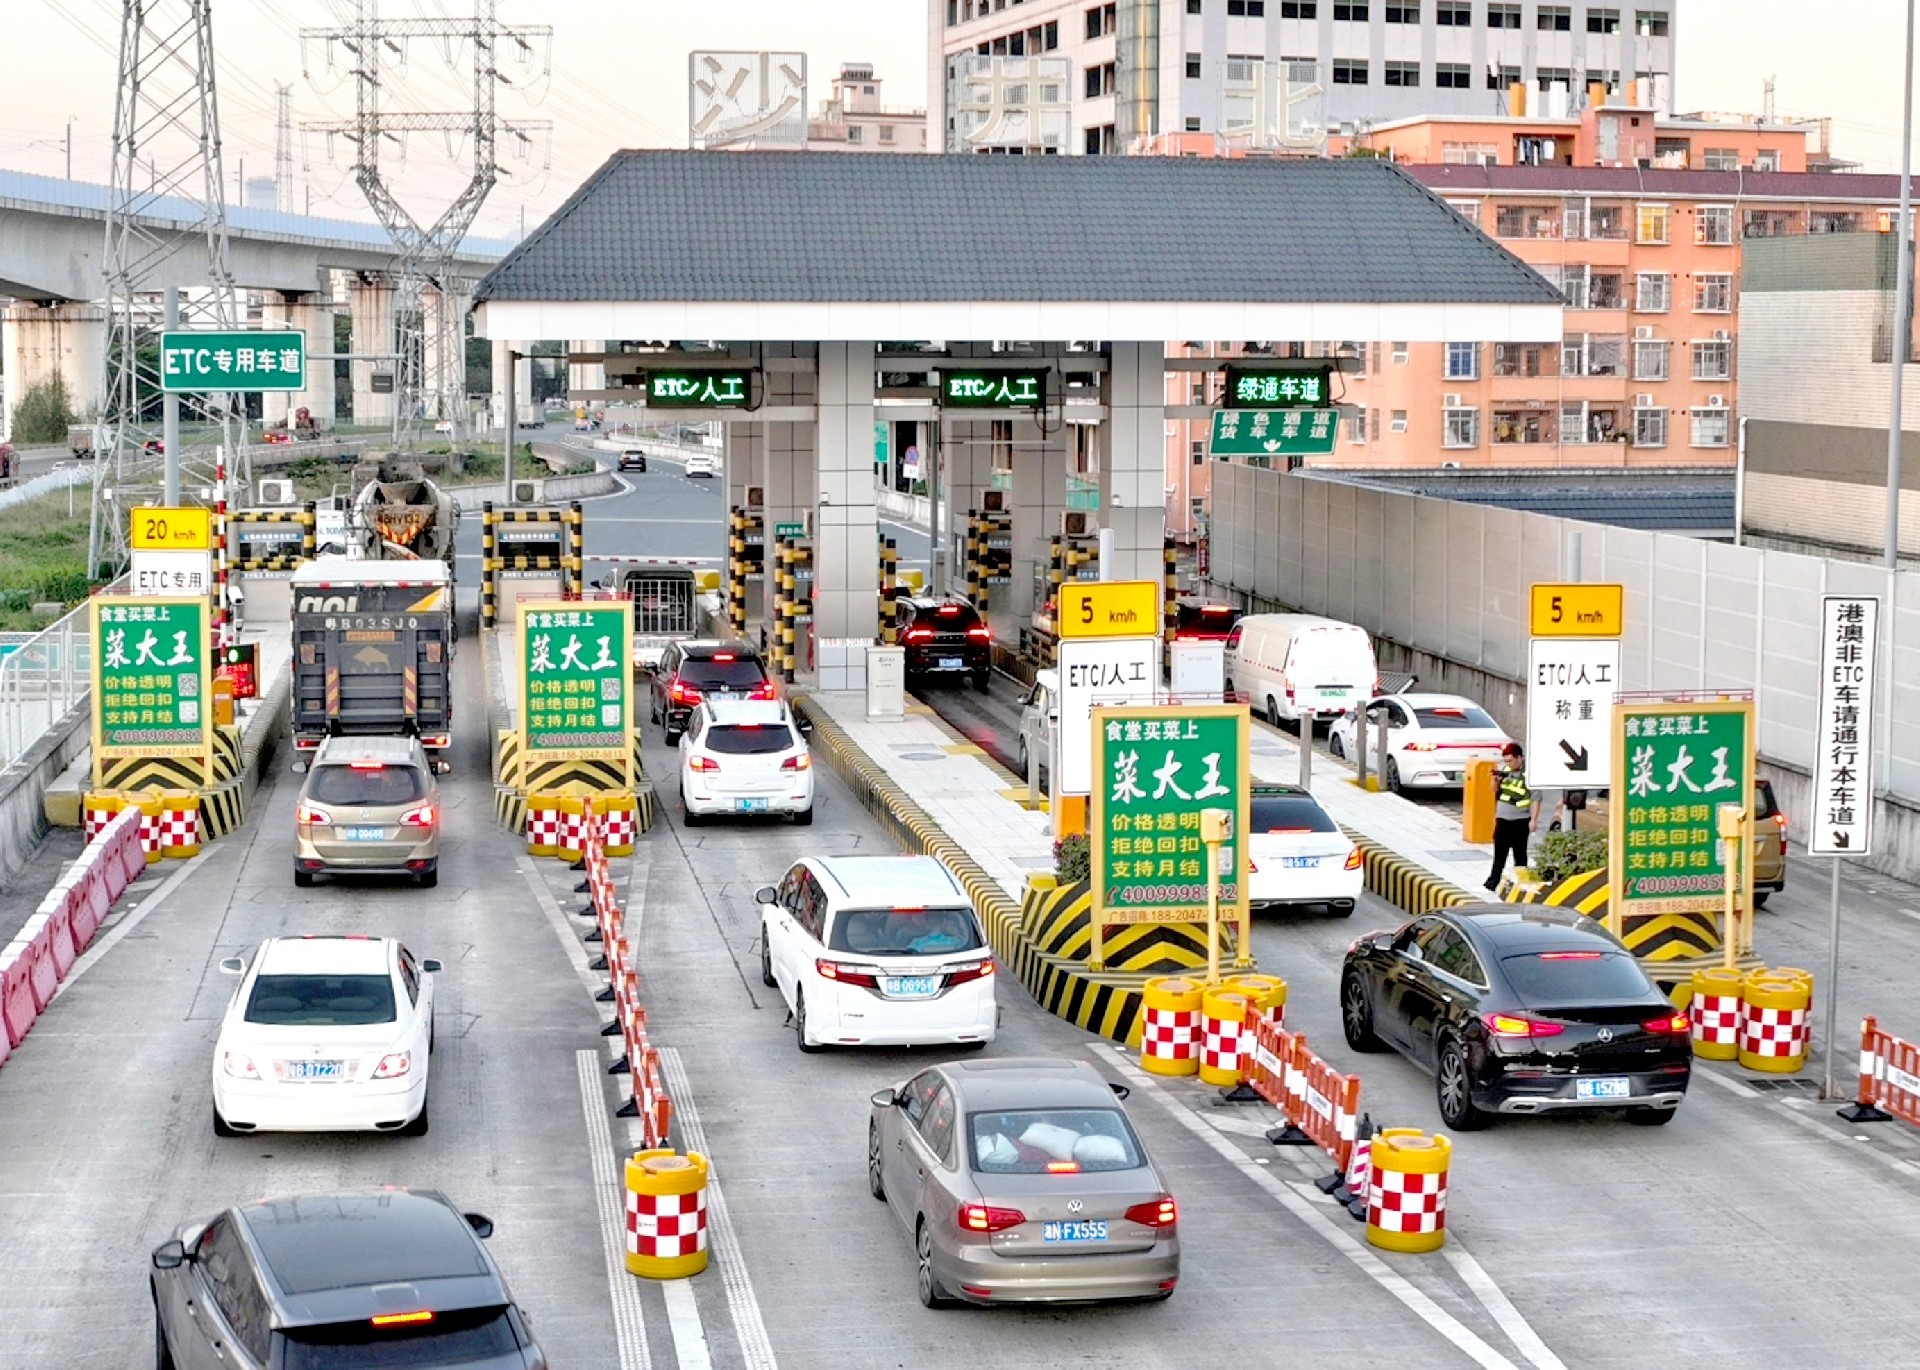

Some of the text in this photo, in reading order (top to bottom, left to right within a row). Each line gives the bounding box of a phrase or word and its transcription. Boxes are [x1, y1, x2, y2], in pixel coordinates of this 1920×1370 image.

[165, 348, 300, 374] ETC专用车道
[654, 376, 745, 402] ETC/人工
[950, 376, 1038, 401] ETC/人工
[1237, 376, 1321, 401] 绿通车道
[1221, 411, 1331, 426] 绿色通道
[146, 519, 196, 540] 20 km/h
[139, 571, 202, 588] ETC专用
[100, 606, 171, 622] 食堂买菜上
[1081, 597, 1137, 624] 5 km/h
[1551, 596, 1603, 624] 5 km/h
[526, 612, 595, 628] 食堂买菜上
[104, 628, 195, 669] 菜大王
[530, 633, 617, 674] 菜大王
[104, 675, 172, 690] 价格透明
[1070, 662, 1146, 687] ETC/人工
[1538, 663, 1611, 685] ETC/人工
[530, 679, 596, 694] 价格透明
[105, 693, 173, 707] 拒绝回扣
[530, 697, 596, 711] 拒绝回扣
[1555, 699, 1594, 720] 称重
[105, 711, 173, 725] 支持月结
[531, 714, 596, 728] 支持月结
[1827, 603, 1865, 826] 港澳非ETC车请通行本车道
[113, 728, 202, 743] 4009998582
[1105, 720, 1200, 742] 食堂买菜上
[1625, 715, 1710, 738] 食堂买菜上
[537, 732, 624, 746] 4009998582
[1111, 748, 1232, 804] 菜大王
[1629, 744, 1737, 798] 菜大王
[1112, 812, 1200, 831] 价格透明
[1629, 805, 1710, 824] 价格透明
[1112, 836, 1200, 855] 拒绝回扣
[1629, 828, 1709, 847] 拒绝回扣
[1112, 859, 1200, 878] 支持月结
[1629, 851, 1709, 869] 支持月结
[1152, 908, 1234, 921] 188-2047-13
[1666, 899, 1741, 911] 188-2047-98
